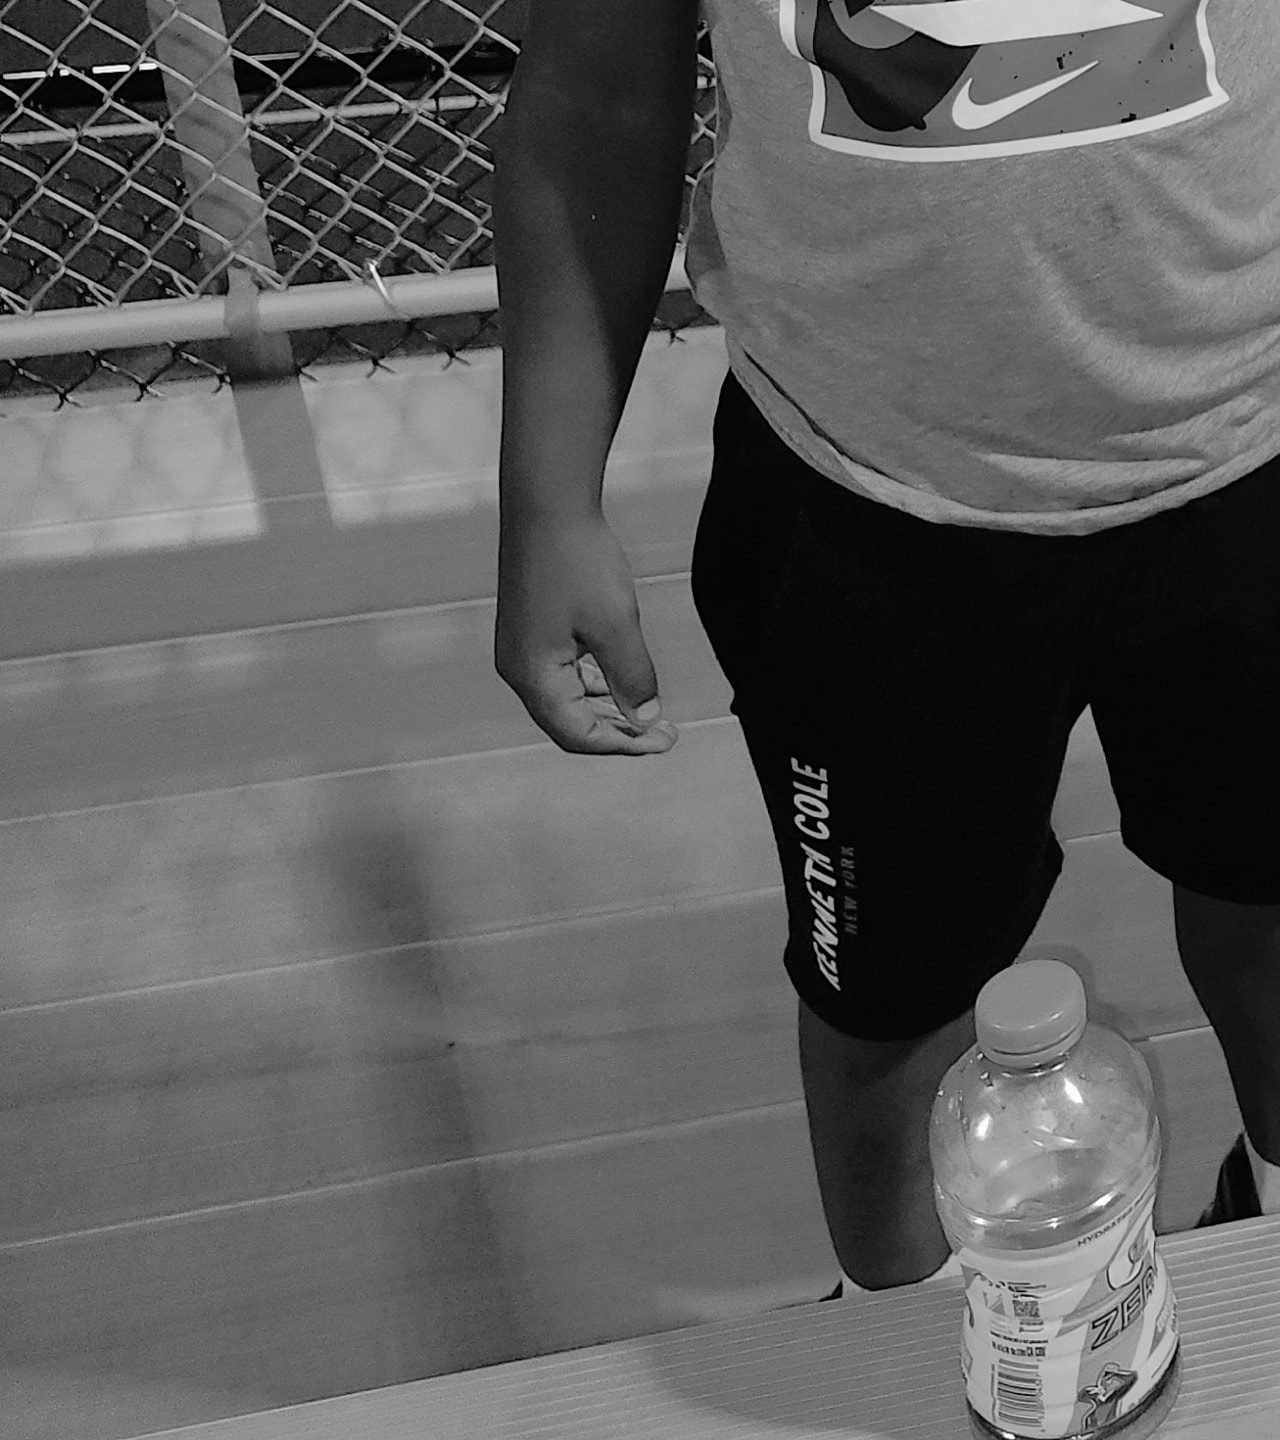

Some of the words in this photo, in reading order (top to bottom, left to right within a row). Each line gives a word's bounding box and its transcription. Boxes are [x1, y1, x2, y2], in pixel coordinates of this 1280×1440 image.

[791, 757, 830, 840] COLE
[840, 846, 858, 889] YORK
[800, 841, 841, 991] KENNETH
[843, 895, 858, 935] NEW
[1090, 1264, 1156, 1351] ZER
